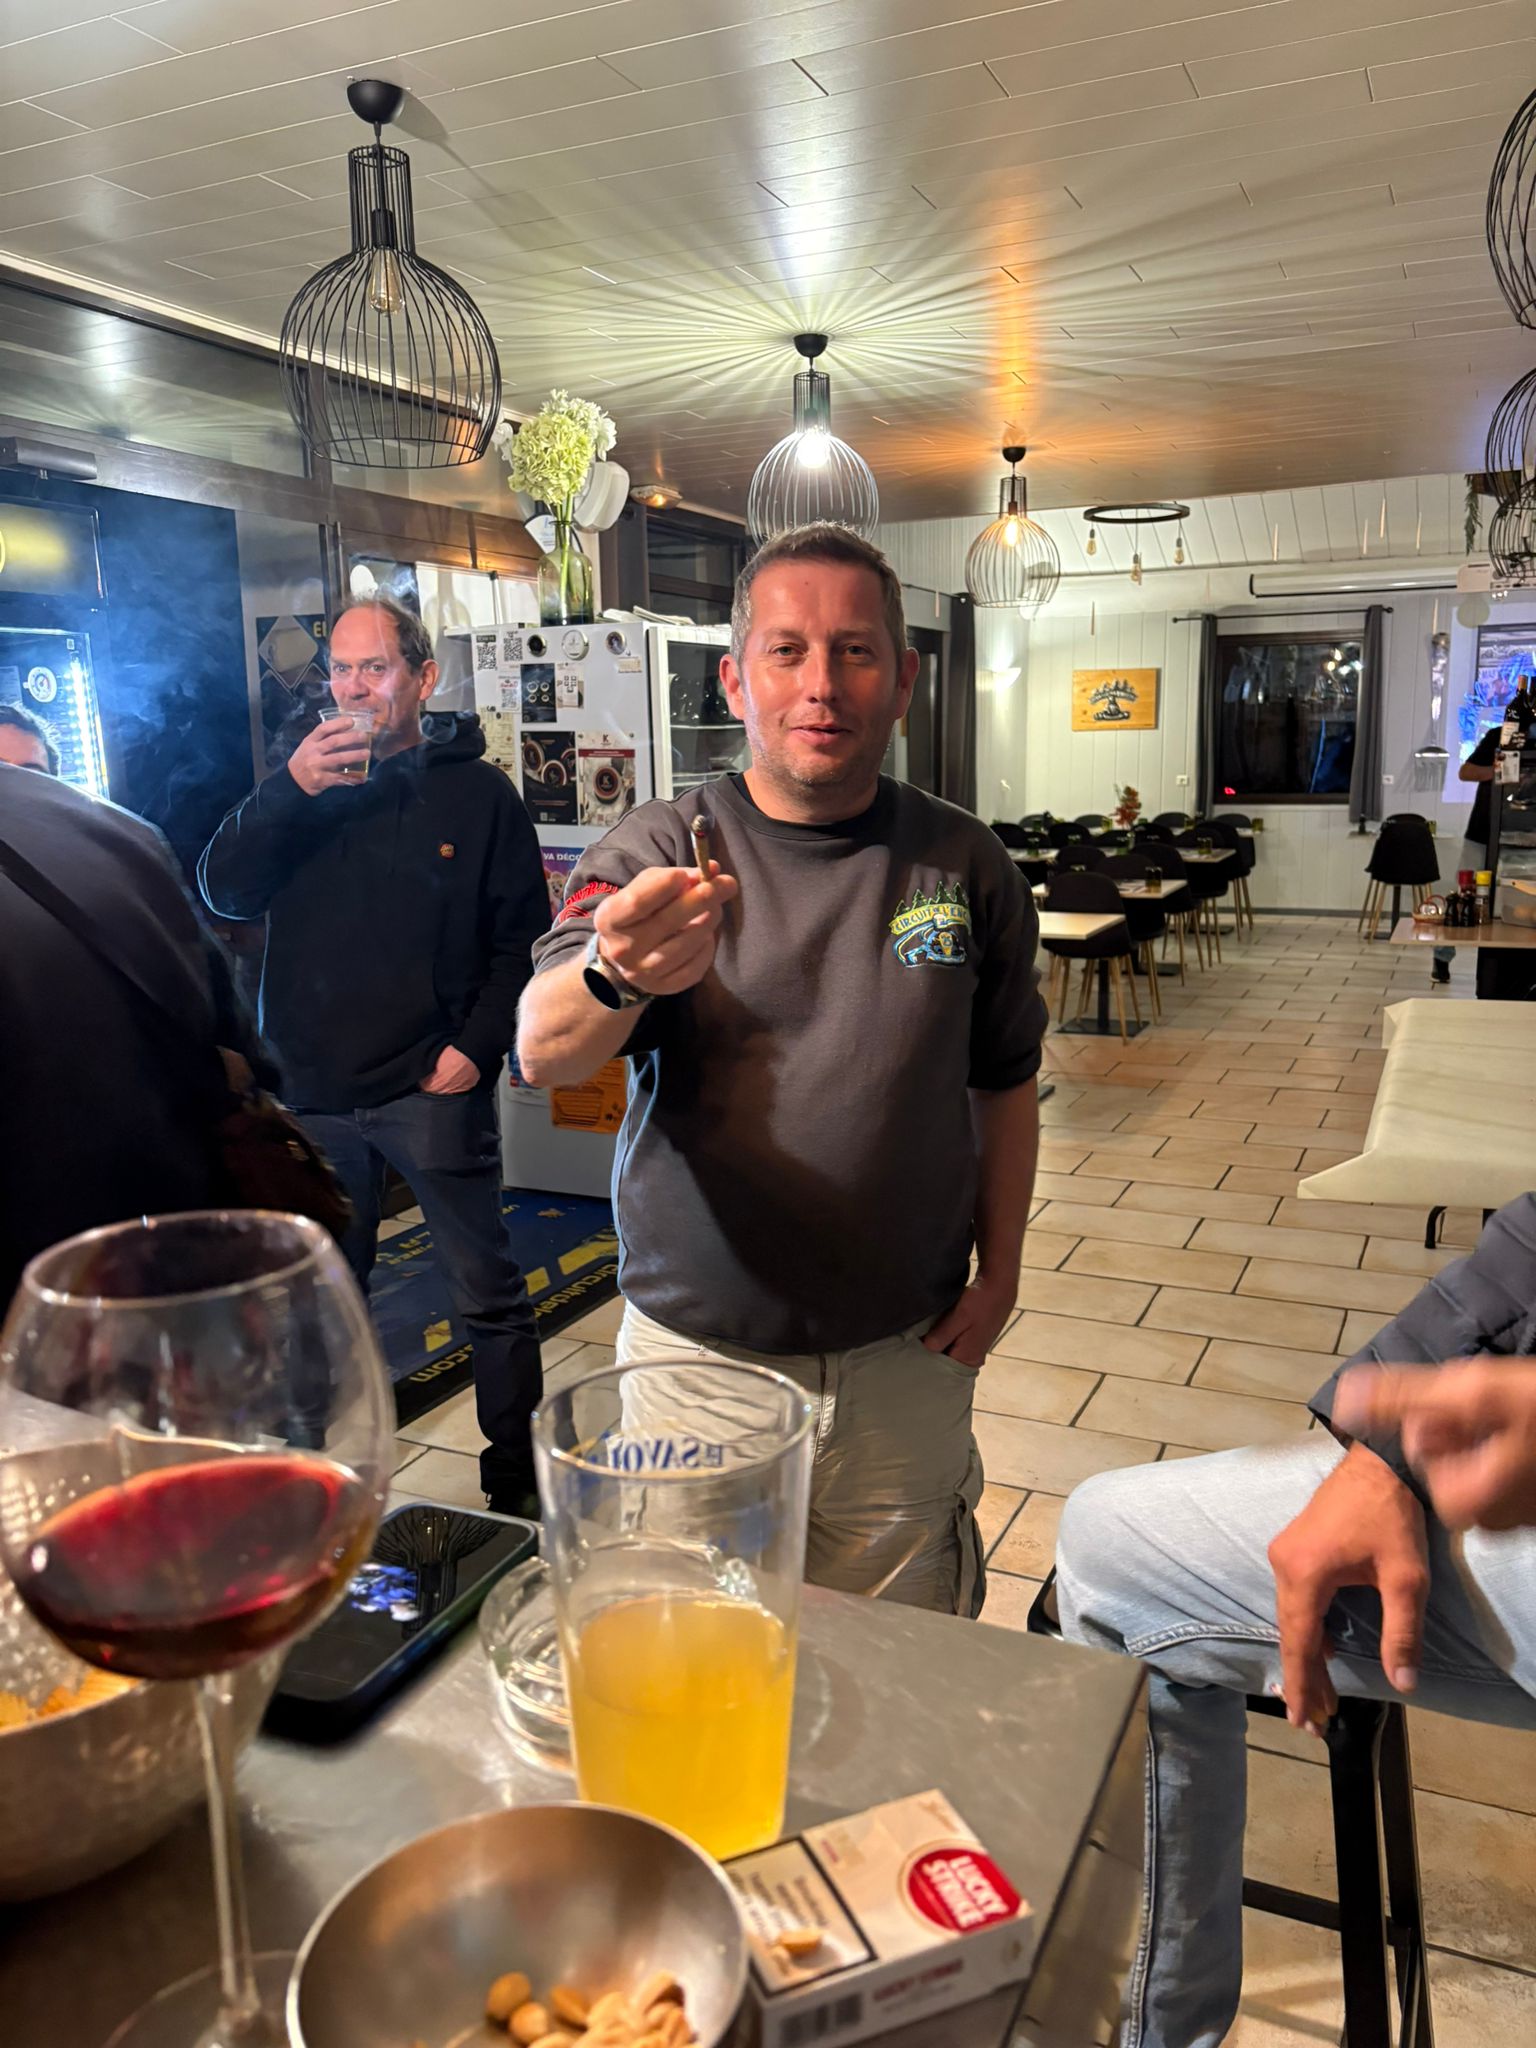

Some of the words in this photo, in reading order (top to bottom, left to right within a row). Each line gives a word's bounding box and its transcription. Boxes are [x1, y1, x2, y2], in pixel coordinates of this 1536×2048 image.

[895, 908, 933, 931] CIRCUIT
[922, 1859, 985, 1928] STRIKE
[949, 1855, 1009, 1916] LUCKY
